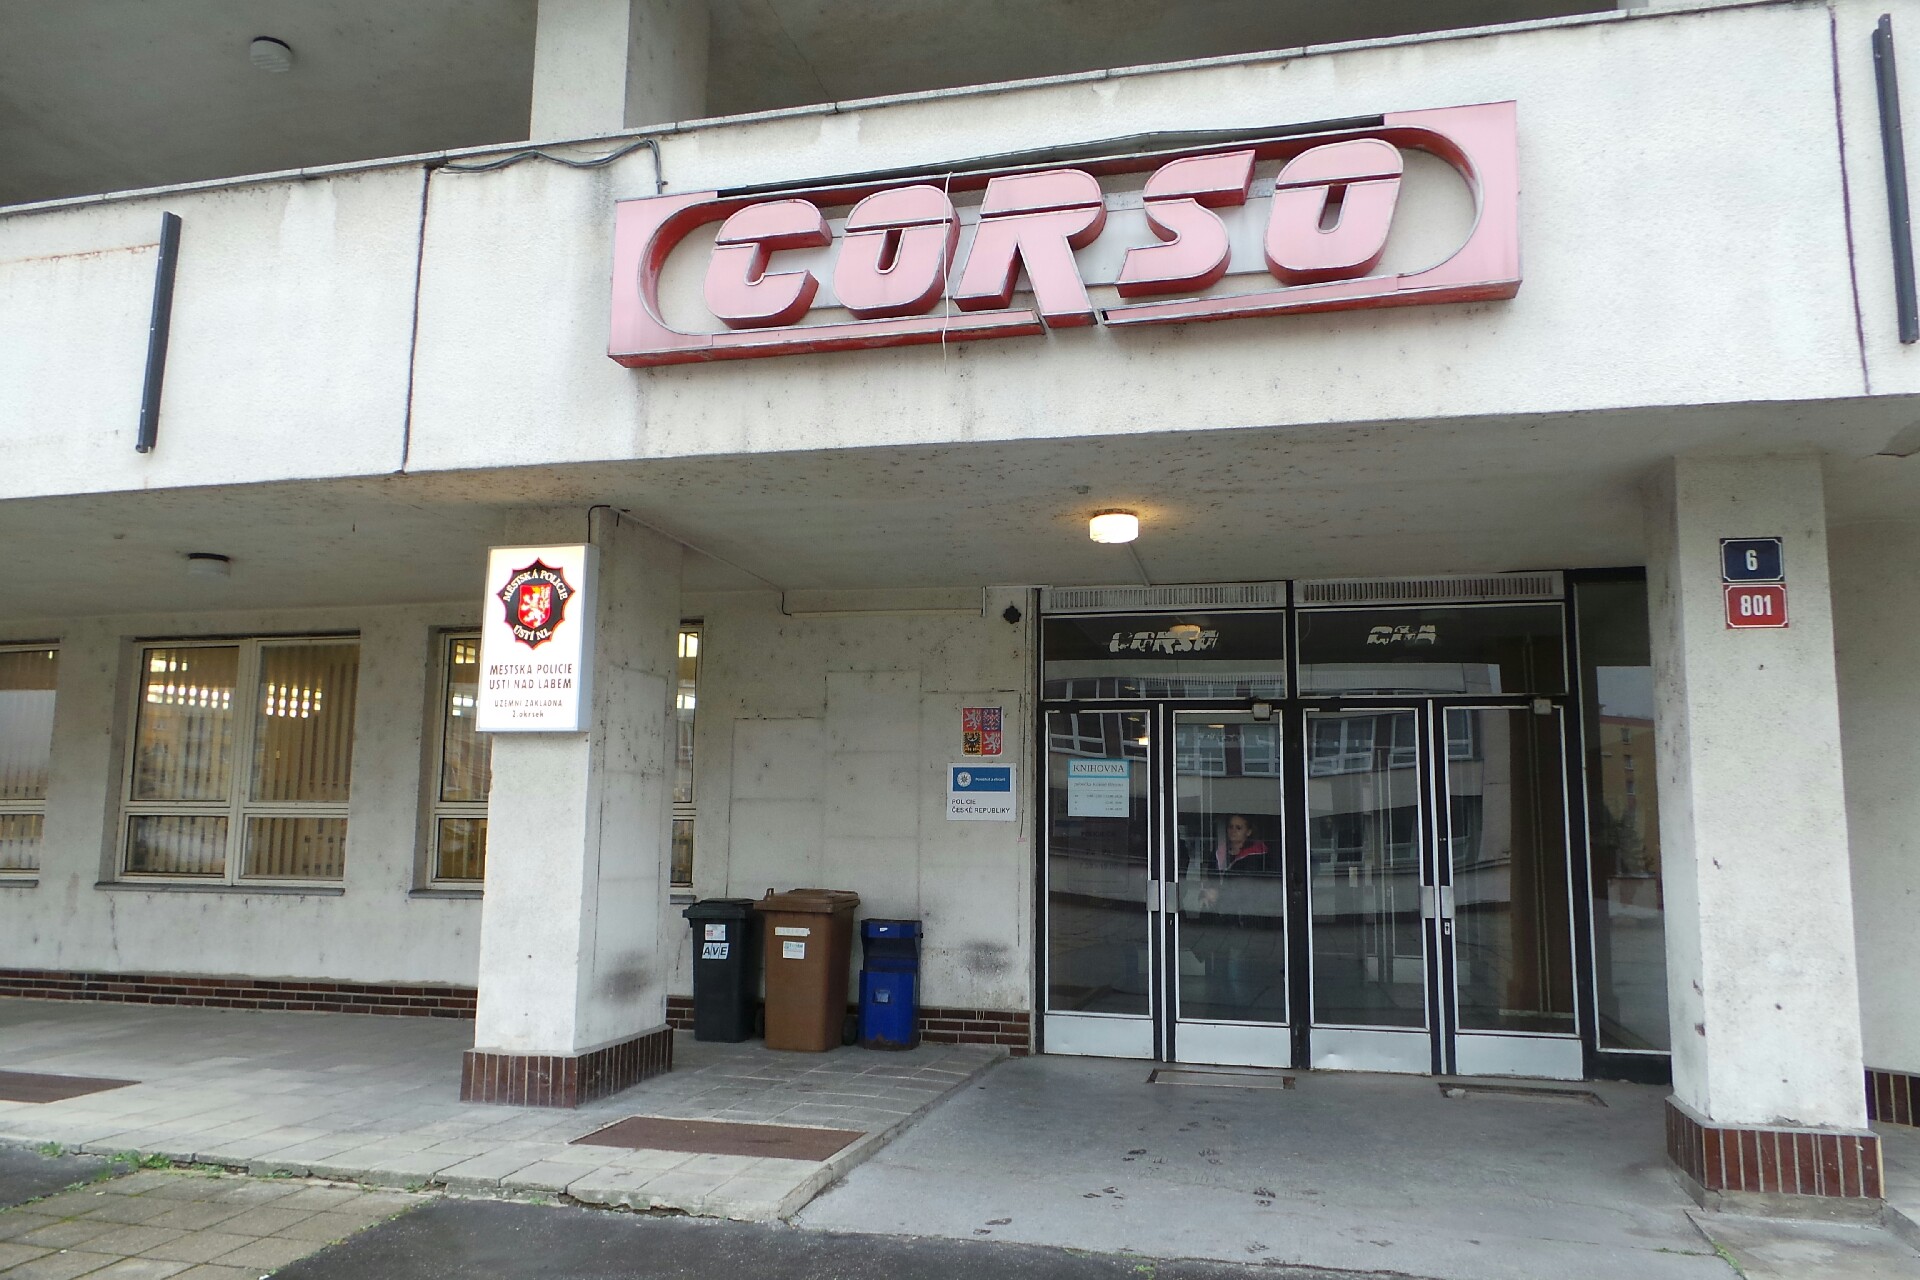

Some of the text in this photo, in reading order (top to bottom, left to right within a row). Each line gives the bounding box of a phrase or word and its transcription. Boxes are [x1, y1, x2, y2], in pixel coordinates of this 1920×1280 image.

[703, 138, 1405, 329] CORSO
[1745, 549, 1758, 571] 6
[540, 570, 568, 600] POLICIE
[1740, 594, 1773, 616] 801
[537, 663, 572, 674] POLICIE
[514, 679, 534, 689] NAD
[538, 678, 572, 689] LABEM
[1073, 764, 1124, 773] KNIHOVNA
[703, 947, 727, 957] AVE
